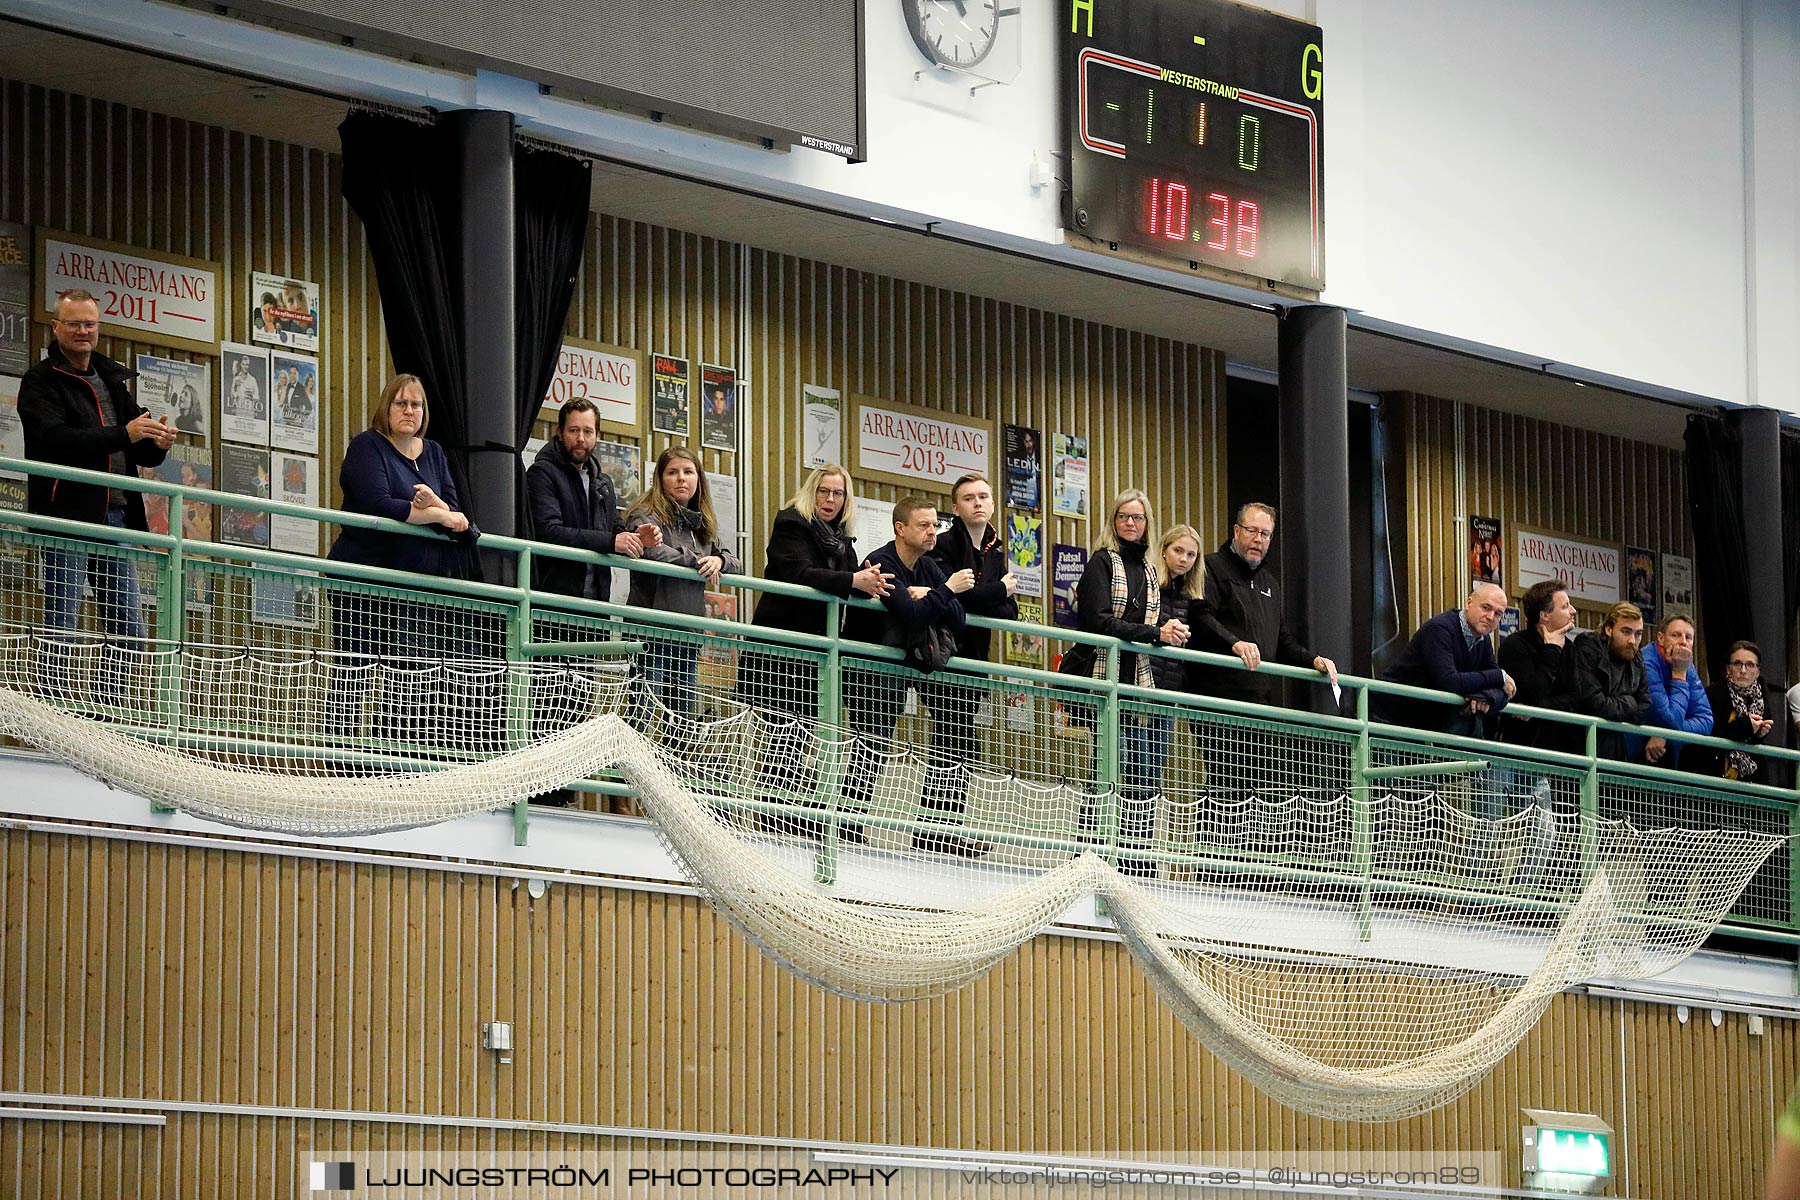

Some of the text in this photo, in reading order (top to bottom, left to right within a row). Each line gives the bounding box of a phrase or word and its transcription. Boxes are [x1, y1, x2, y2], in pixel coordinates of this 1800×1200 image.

[1159, 67, 1240, 102] WESTERSTRAND
[1301, 43, 1322, 101] G
[801, 135, 854, 157] WESTERSTRAND
[55, 251, 207, 303] ARRANGEMANG
[104, 291, 159, 325] 2011
[544, 377, 588, 404] 012
[862, 412, 984, 456] ARRANGEMANG
[901, 445, 946, 476] 2013
[1007, 457, 1041, 472] LEDIN
[1056, 562, 1085, 573] Sweden
[1058, 552, 1081, 563] Futsal
[1520, 538, 1616, 574] ARRANGEMANG
